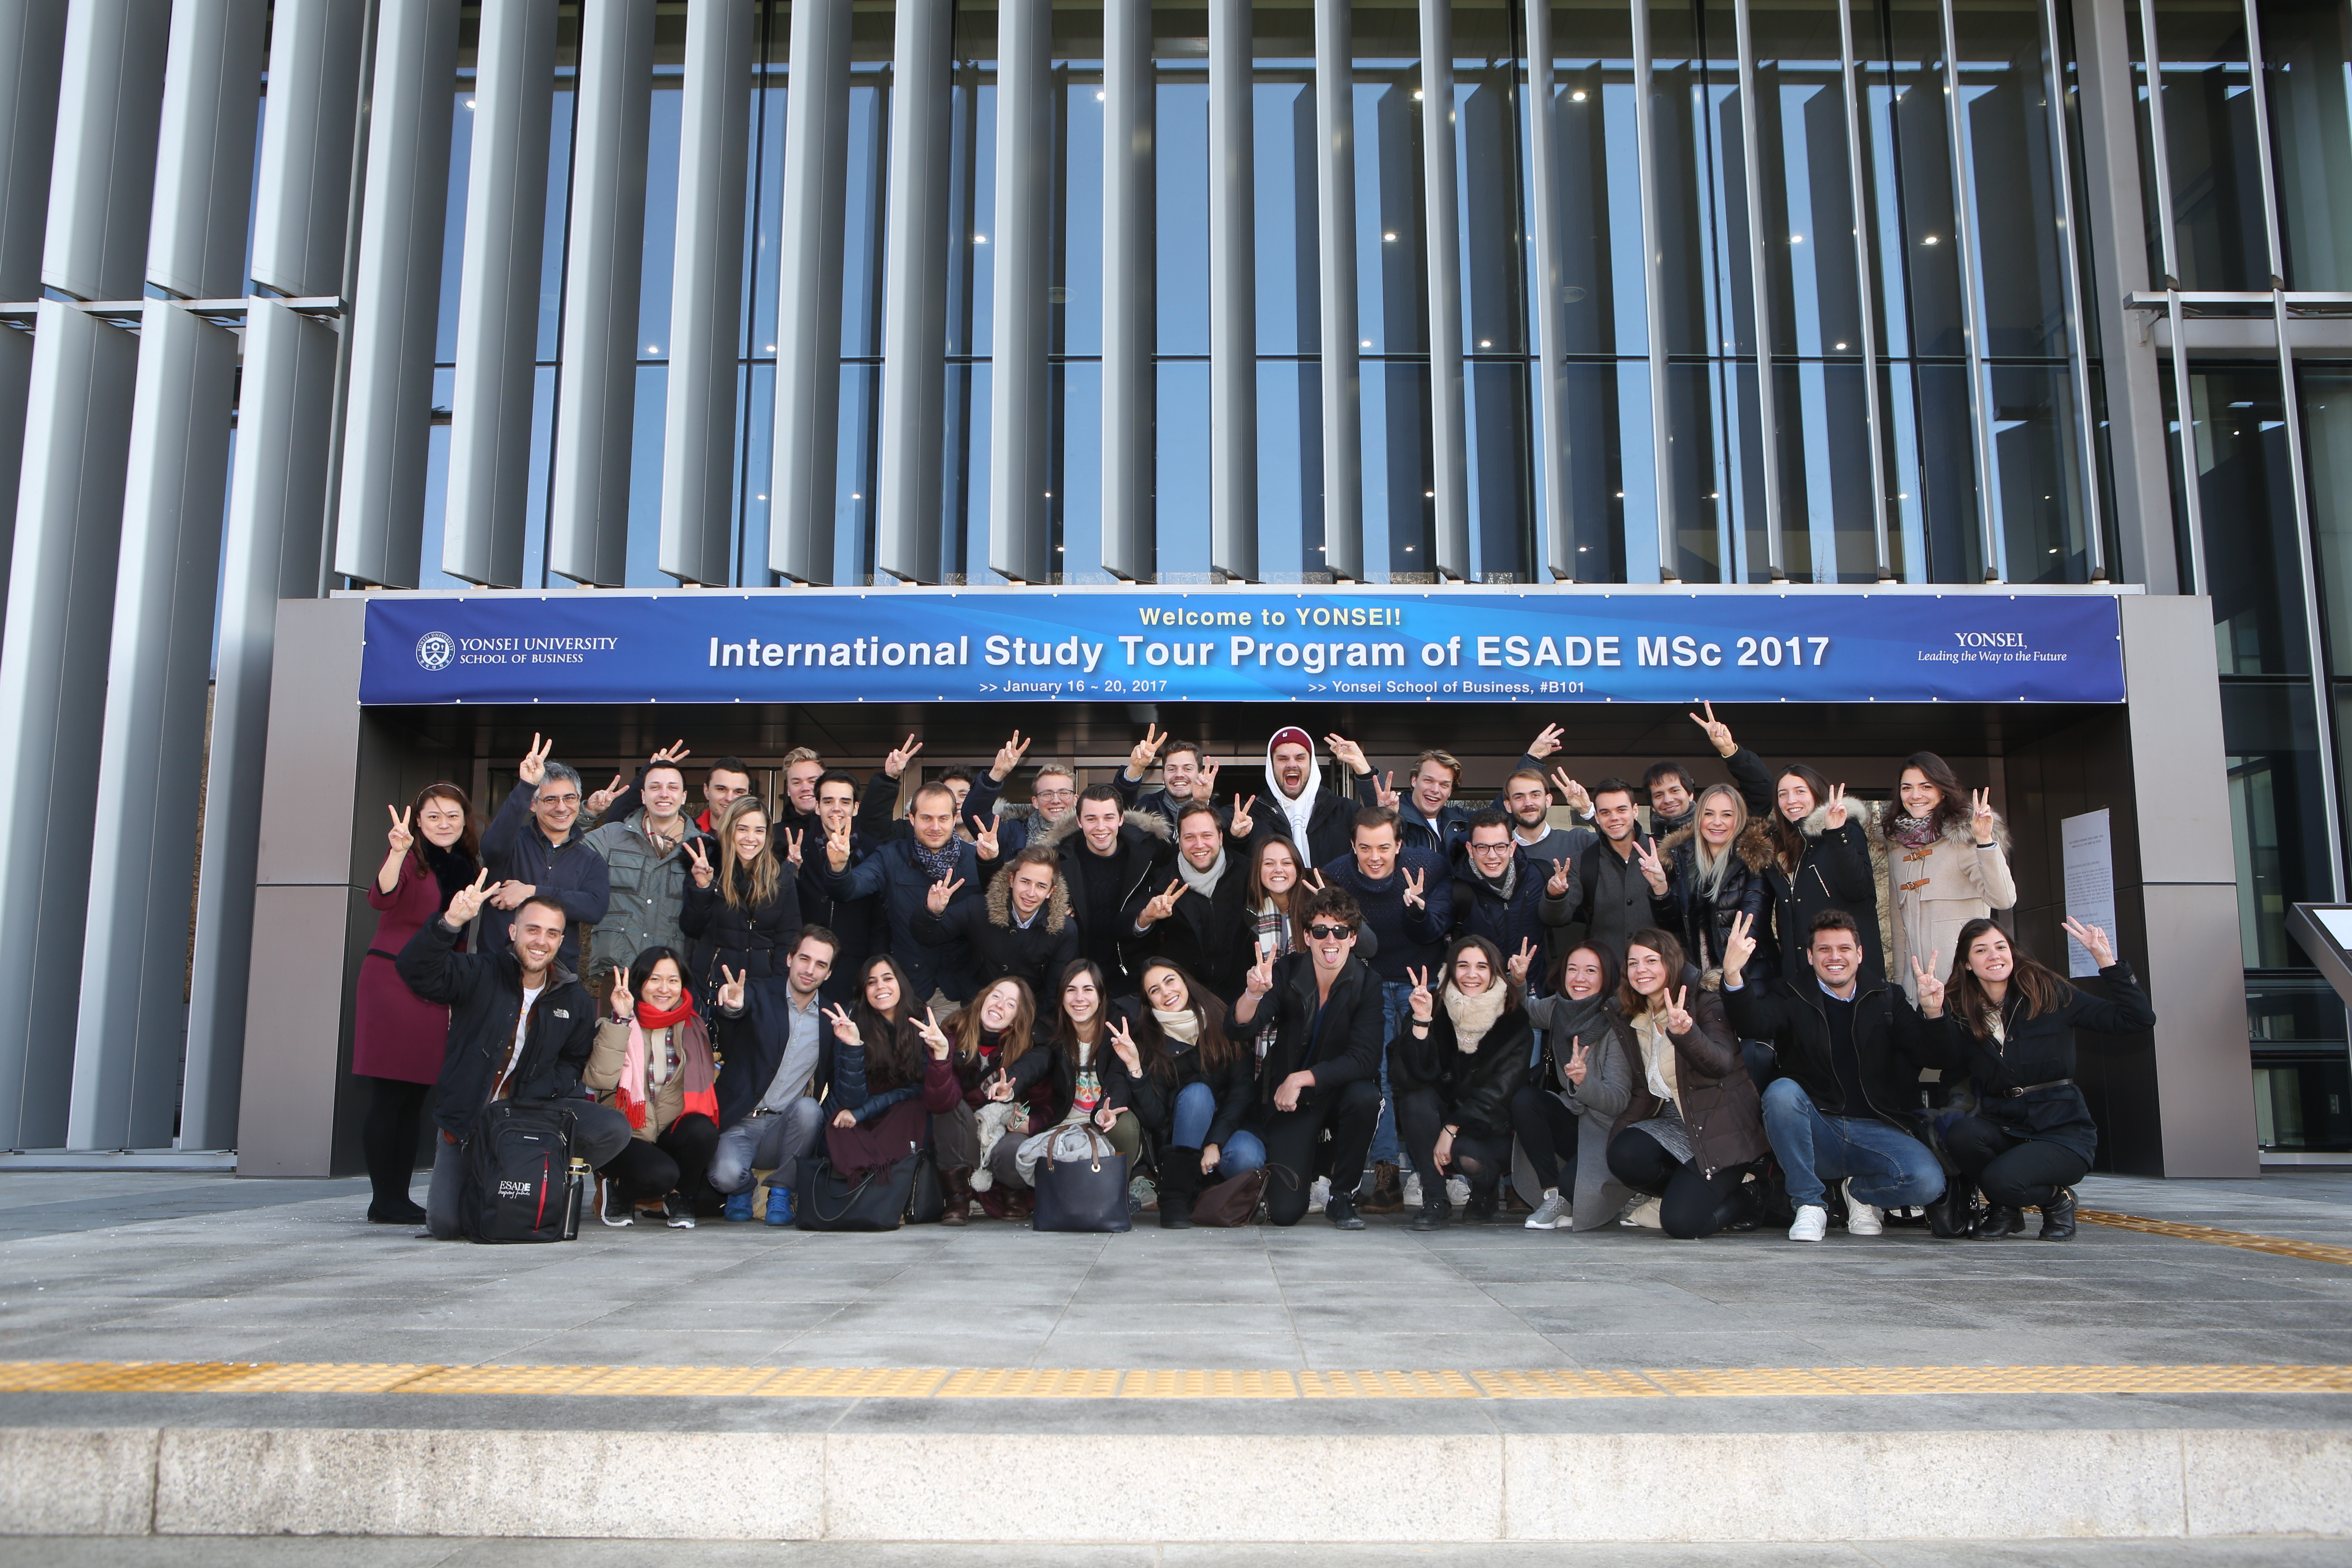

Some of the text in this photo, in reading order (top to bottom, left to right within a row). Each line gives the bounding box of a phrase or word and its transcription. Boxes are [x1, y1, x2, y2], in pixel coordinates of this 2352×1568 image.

[1139, 608, 1401, 626] Welcome to YONSEI!
[418, 633, 454, 651] YONSEI UNIVERSITY
[459, 637, 619, 650] YONSEI UNIVERSITY
[1954, 633, 2027, 649] YONSEI,
[460, 653, 584, 664] SCHOOL OF BUSINESS
[709, 635, 1829, 673] International Study Tour Program of ESADE MSc 2017
[1918, 650, 2067, 664] Leading the Way to the Future
[1003, 680, 1062, 694] January
[1067, 680, 1085, 692] 16
[1104, 680, 1127, 694] 20,
[1132, 680, 1167, 692] 2017
[1332, 681, 1381, 693] Yonsei
[1386, 680, 1437, 693] School
[1443, 681, 1458, 693] of
[1463, 681, 1534, 695] Business,
[1539, 681, 1584, 693] #B101
[499, 1180, 531, 1192] ESADE
